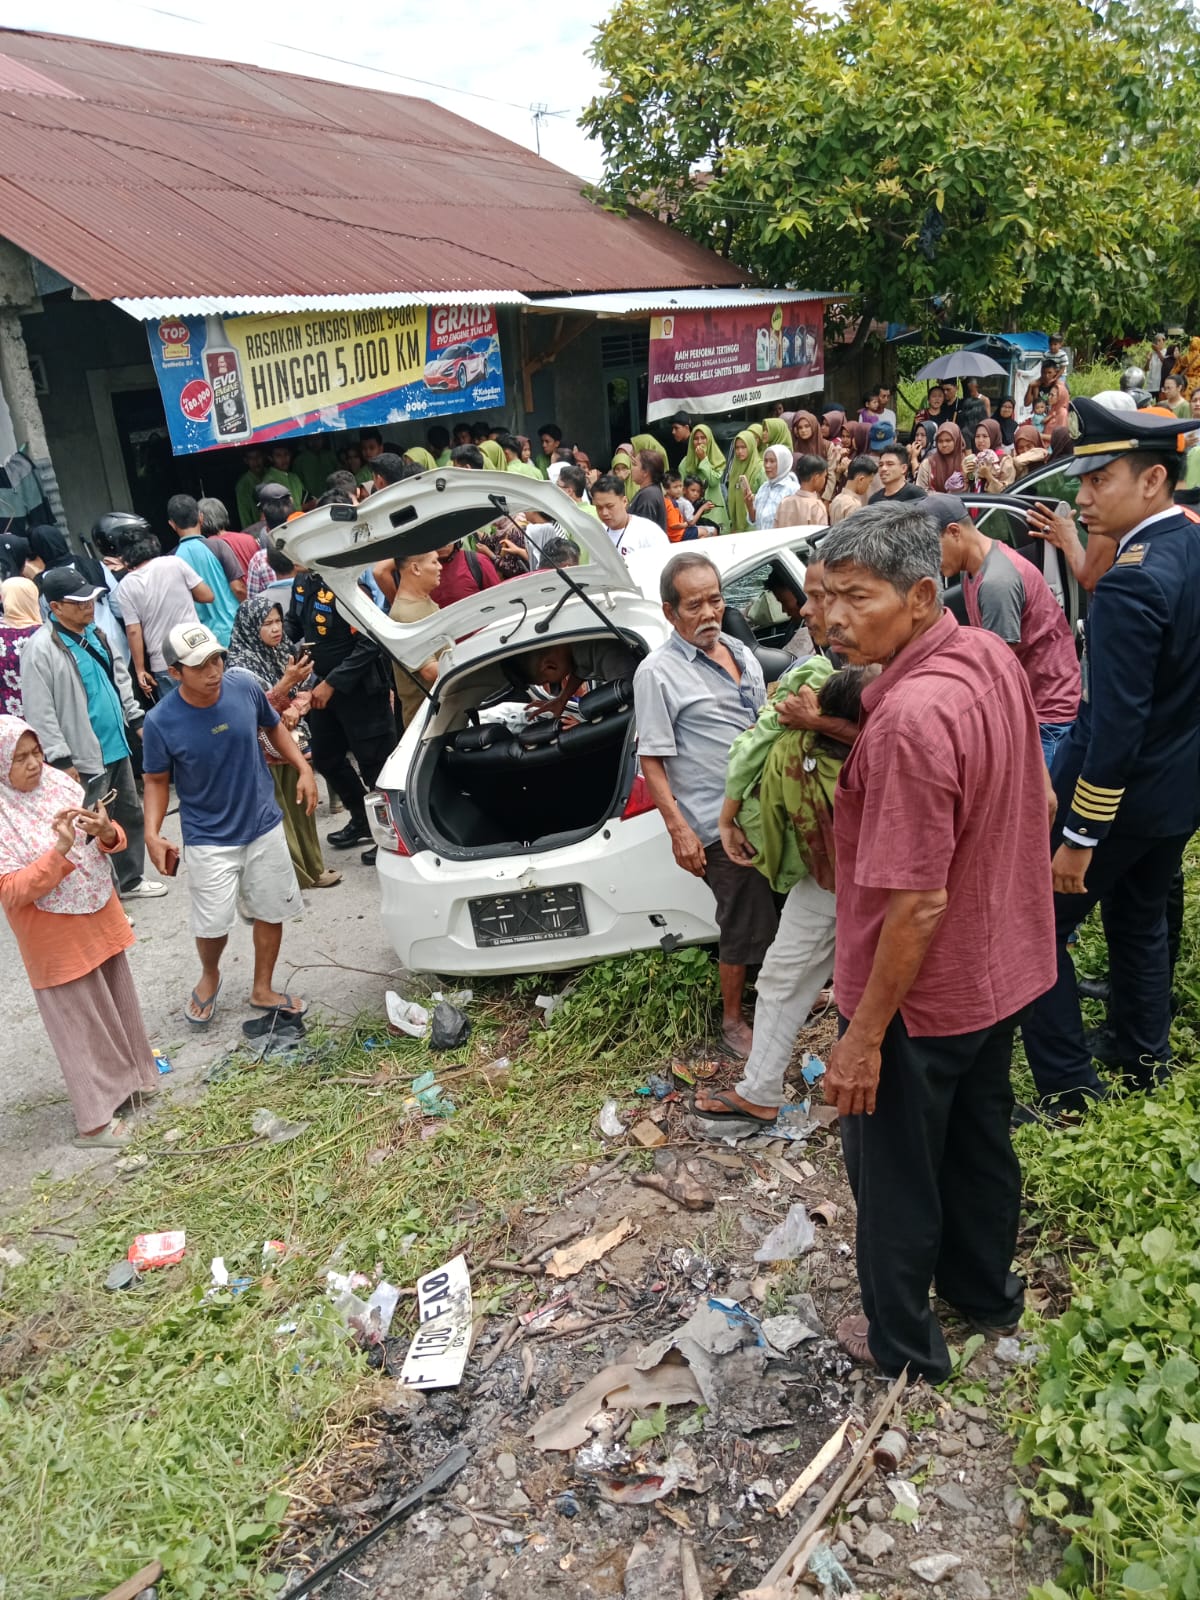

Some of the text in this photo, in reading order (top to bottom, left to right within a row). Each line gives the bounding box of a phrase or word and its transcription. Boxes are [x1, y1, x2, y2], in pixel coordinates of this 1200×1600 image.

[434, 303, 491, 335] GRATIS
[162, 327, 186, 339] TOP
[246, 304, 417, 361] RASAKAN SENSASI MOBIL SPORT
[449, 329, 470, 343] ENGINE
[484, 323, 493, 332] UP
[251, 329, 421, 410] HINGGA 5.000 KM
[213, 371, 237, 390] EVO
[215, 382, 239, 397] ENGINE
[215, 389, 239, 405] TUNE UP
[411, 1327, 452, 1359] 1150
[403, 1375, 437, 1385] F
